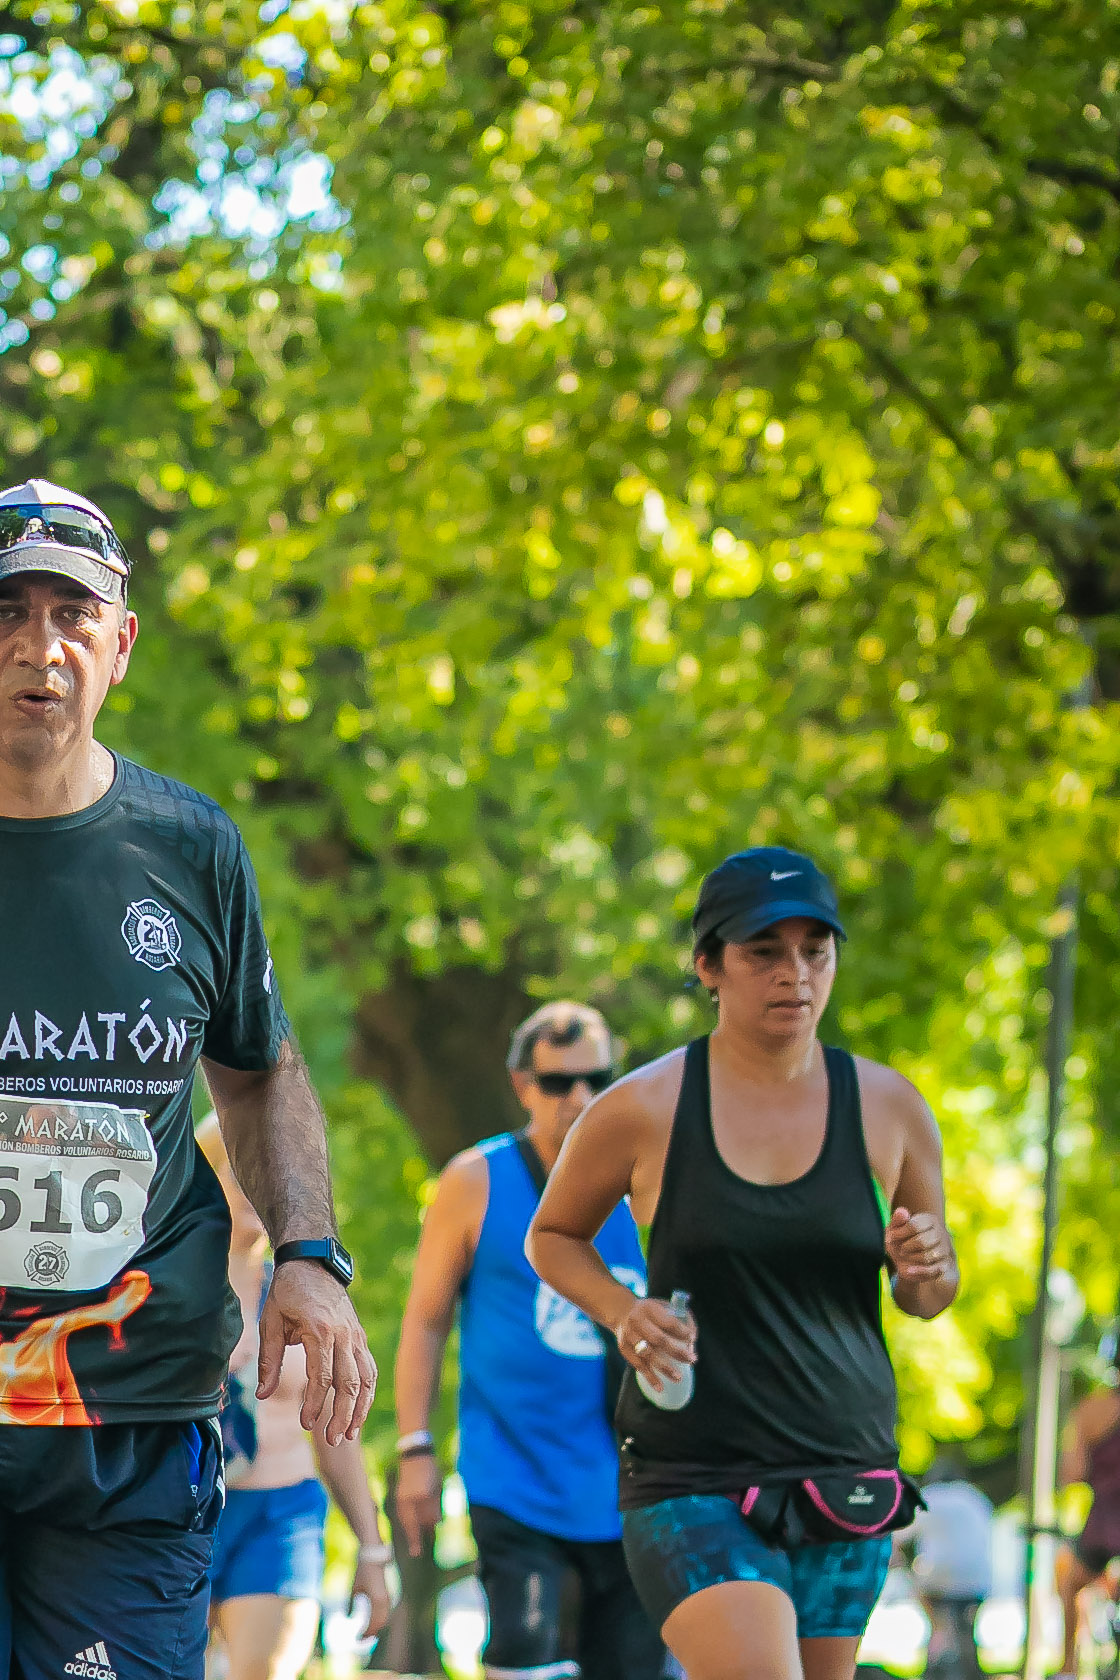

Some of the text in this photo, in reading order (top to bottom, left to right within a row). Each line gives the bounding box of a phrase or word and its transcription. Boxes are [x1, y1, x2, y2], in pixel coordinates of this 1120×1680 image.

[49, 1077, 144, 1095] VOLUNTARIOS
[14, 1112, 130, 1143] MARATÓN
[16, 1142, 62, 1155] BOMBEROS
[63, 1146, 114, 1157] VOLUNTARIOS
